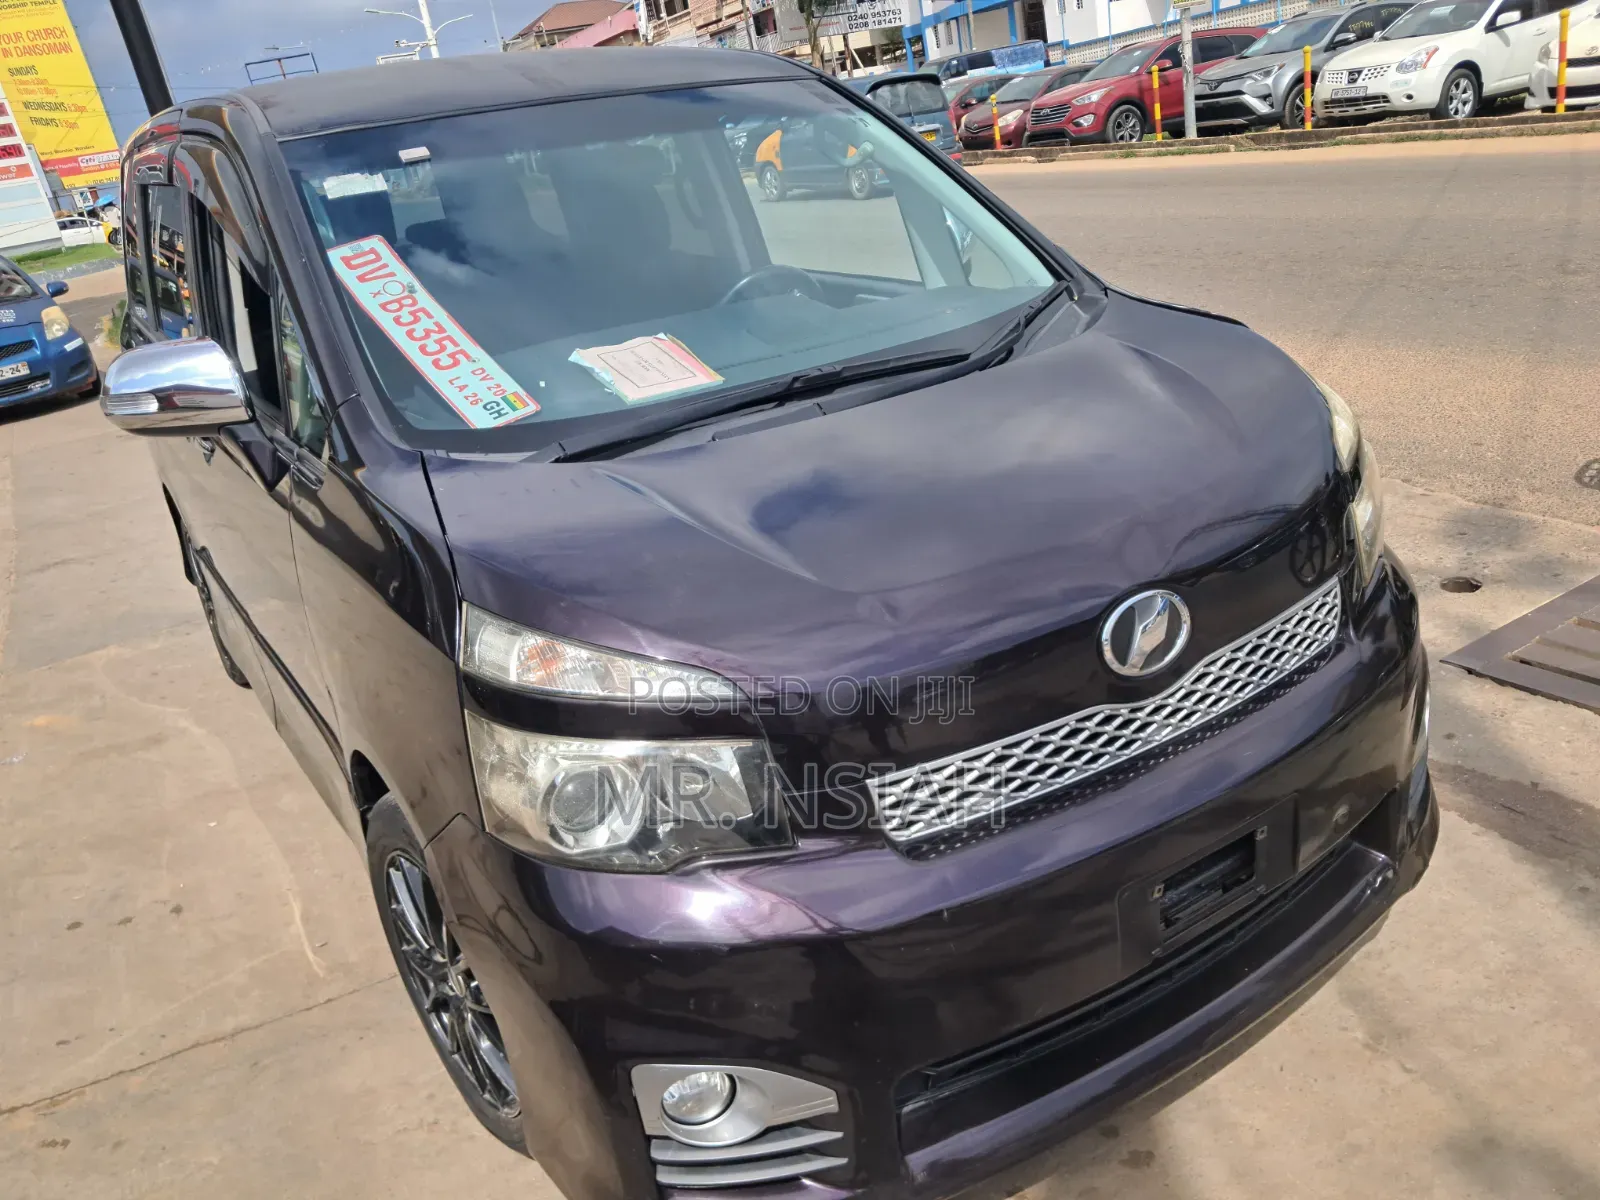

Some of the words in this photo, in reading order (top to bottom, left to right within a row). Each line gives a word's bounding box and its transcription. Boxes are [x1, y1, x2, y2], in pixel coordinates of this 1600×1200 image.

[847, 13, 869, 21] 0240
[848, 22, 870, 30] 0208
[26, 27, 68, 42] CHURCH
[1, 47, 13, 58] IN
[14, 41, 73, 57] DANSOMAN
[8, 65, 38, 77] SUNDAYS
[22, 101, 68, 112] WEDNESDAYS
[29, 116, 59, 128] FRIDAYS
[340, 246, 397, 284] DV
[378, 293, 473, 371] B5355
[470, 366, 495, 381] DV
[486, 383, 508, 397] 20
[447, 376, 469, 393] LA
[463, 392, 484, 406] 26
[482, 400, 510, 421] GH
